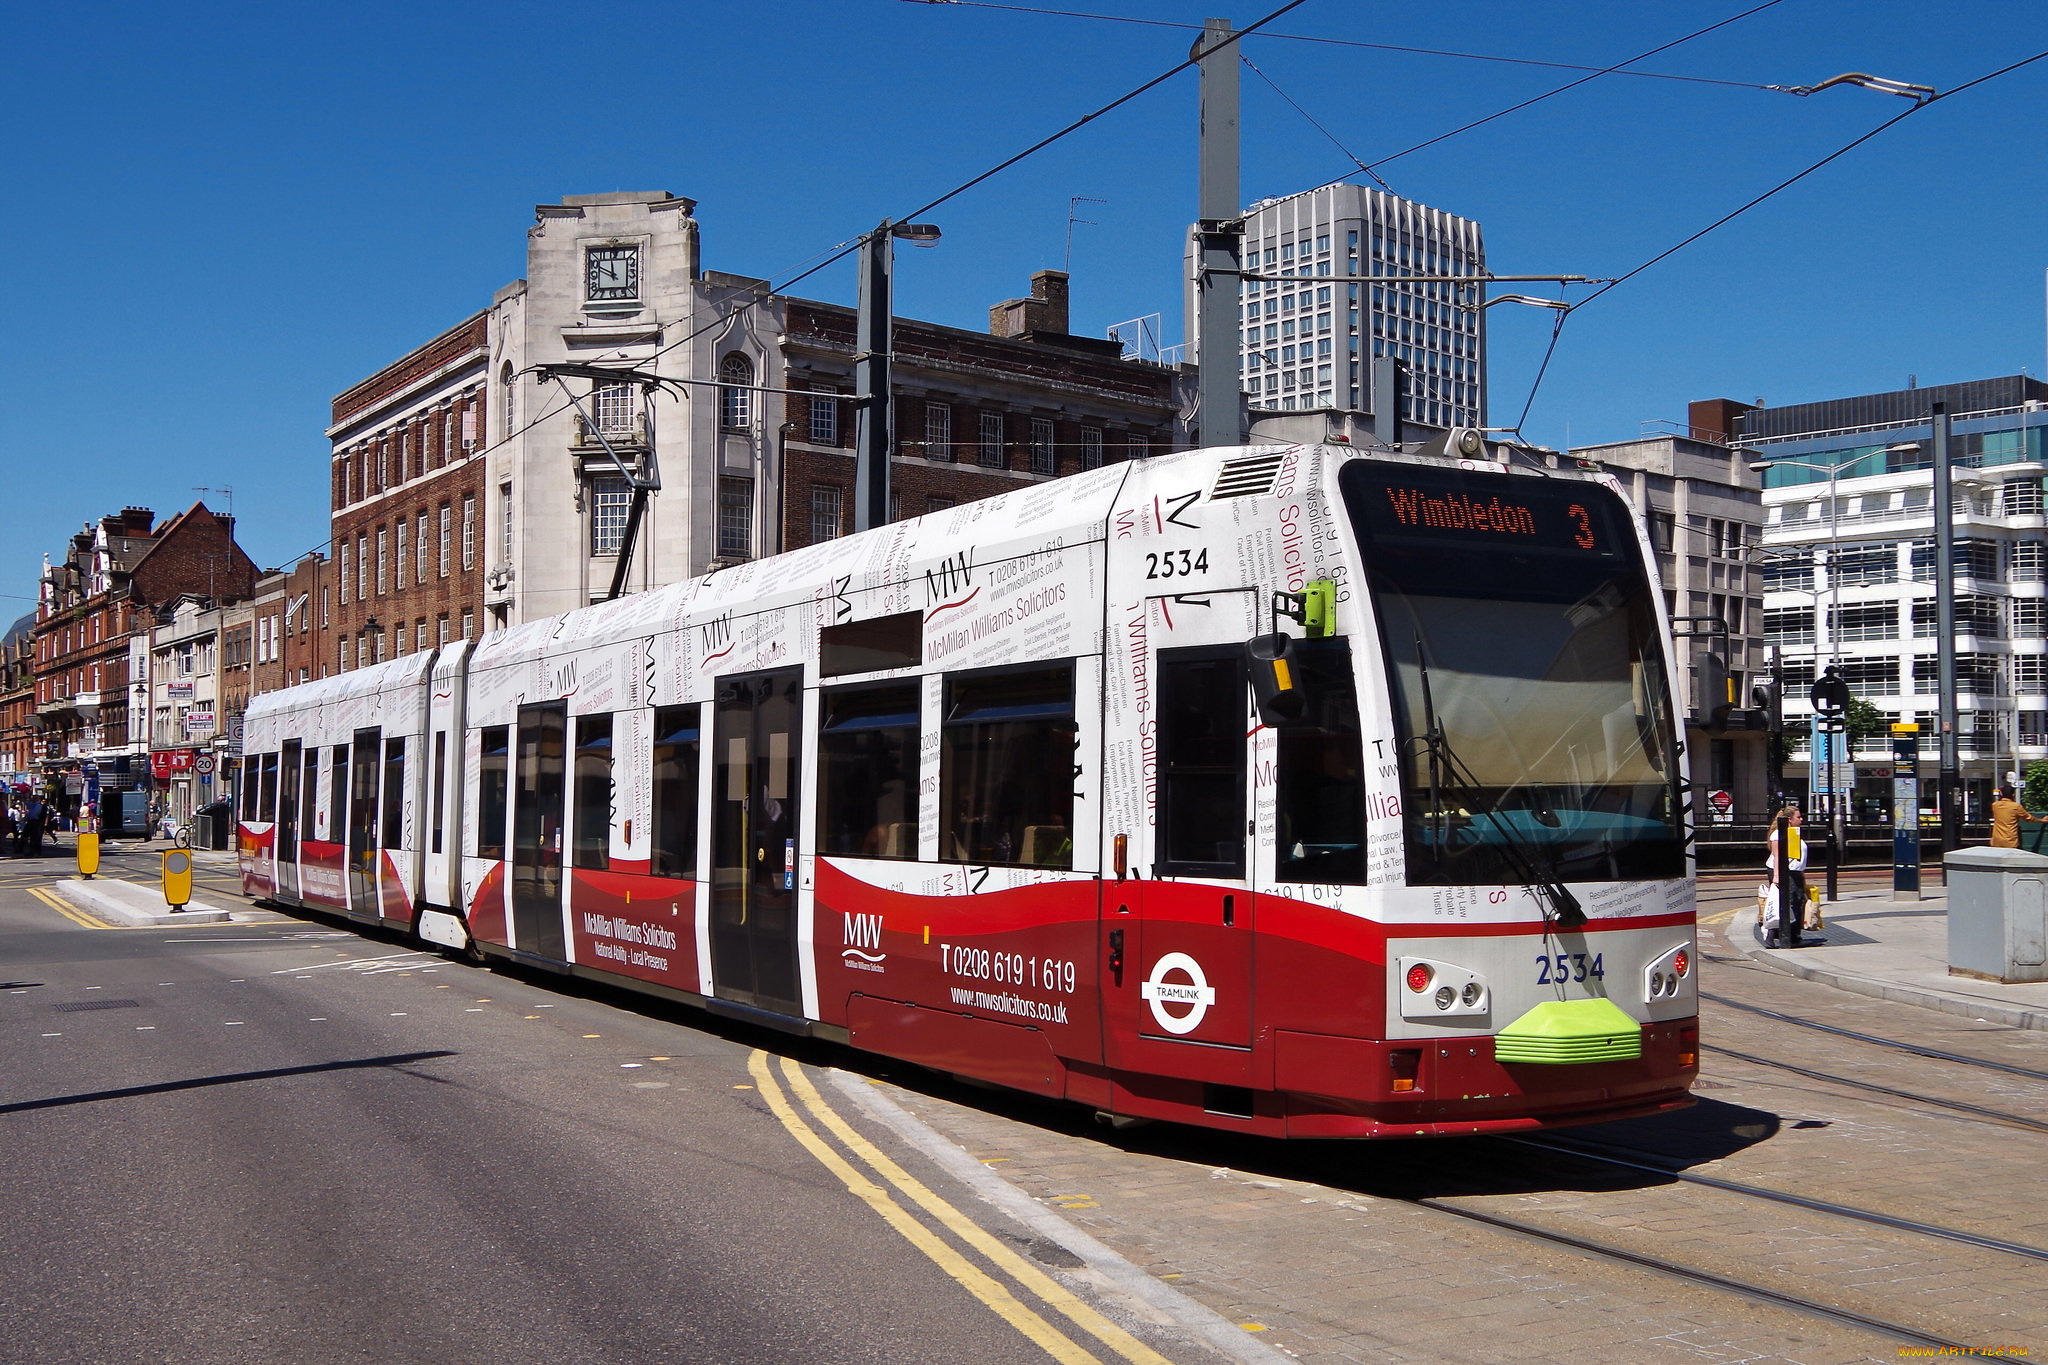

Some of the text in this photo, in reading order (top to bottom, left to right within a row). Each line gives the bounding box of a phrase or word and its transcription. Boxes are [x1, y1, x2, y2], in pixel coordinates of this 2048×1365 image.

[1386, 487, 1595, 549] Wimbledon 3
[901, 554, 911, 591] 0208
[926, 544, 976, 607] MW
[989, 535, 1063, 587] T 0208 619 1 619
[990, 556, 1064, 602] www.mwsolicitors.co.uk
[1146, 547, 1208, 580] 2534
[702, 608, 732, 656] MW
[928, 582, 1066, 663] McMillan Williams Solicitors
[757, 642, 787, 671] Solicitors
[1128, 614, 1150, 713] Williams
[557, 657, 578, 695] MW
[198, 760, 211, 769] 20
[1372, 739, 1383, 759] T
[1379, 845, 1398, 856] Law,
[1383, 859, 1389, 868] &
[1591, 897, 1623, 913] Commercial
[583, 912, 677, 950] McMillan Williams Solicitors
[843, 911, 884, 949] MW
[594, 941, 613, 959] National
[613, 944, 627, 965] Ability
[630, 948, 643, 966] Local
[644, 951, 668, 971] Presence
[940, 943, 1075, 995] T 0208 619 1 619
[1536, 953, 1605, 985] 2534
[950, 986, 1069, 1025] www.mwsolicitors.co.uk
[1156, 987, 1199, 1000] TRAMLINK
